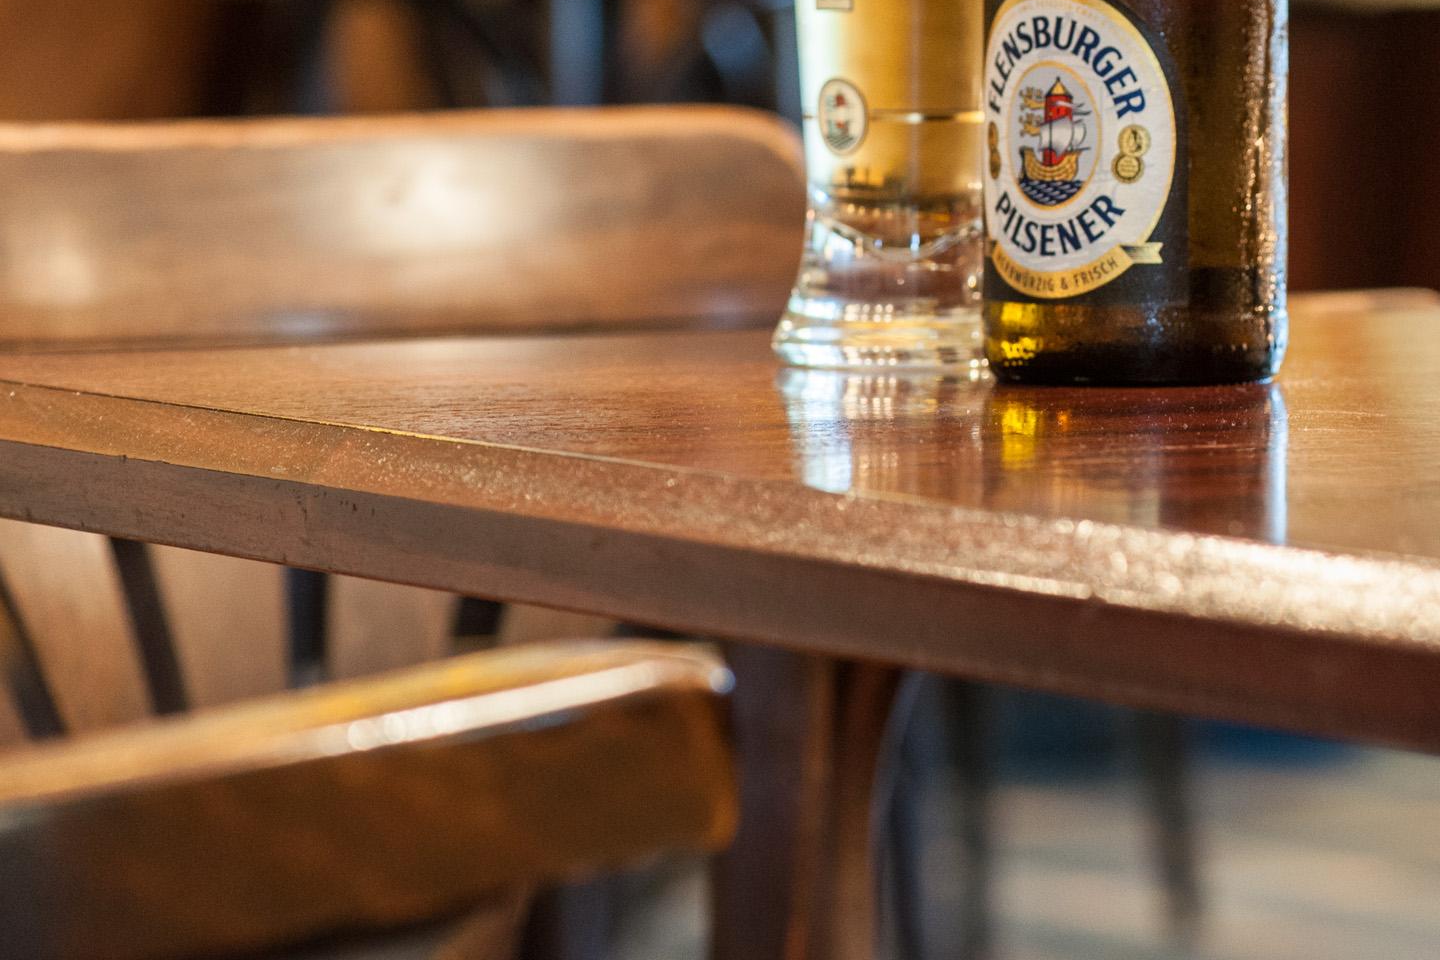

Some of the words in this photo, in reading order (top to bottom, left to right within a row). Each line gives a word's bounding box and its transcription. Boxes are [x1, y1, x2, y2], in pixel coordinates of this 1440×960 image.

[988, 15, 1146, 119] FLENSBURGER
[994, 191, 1126, 257] PILSENER
[1060, 278, 1069, 290] &
[1073, 257, 1119, 287] FRISCH
